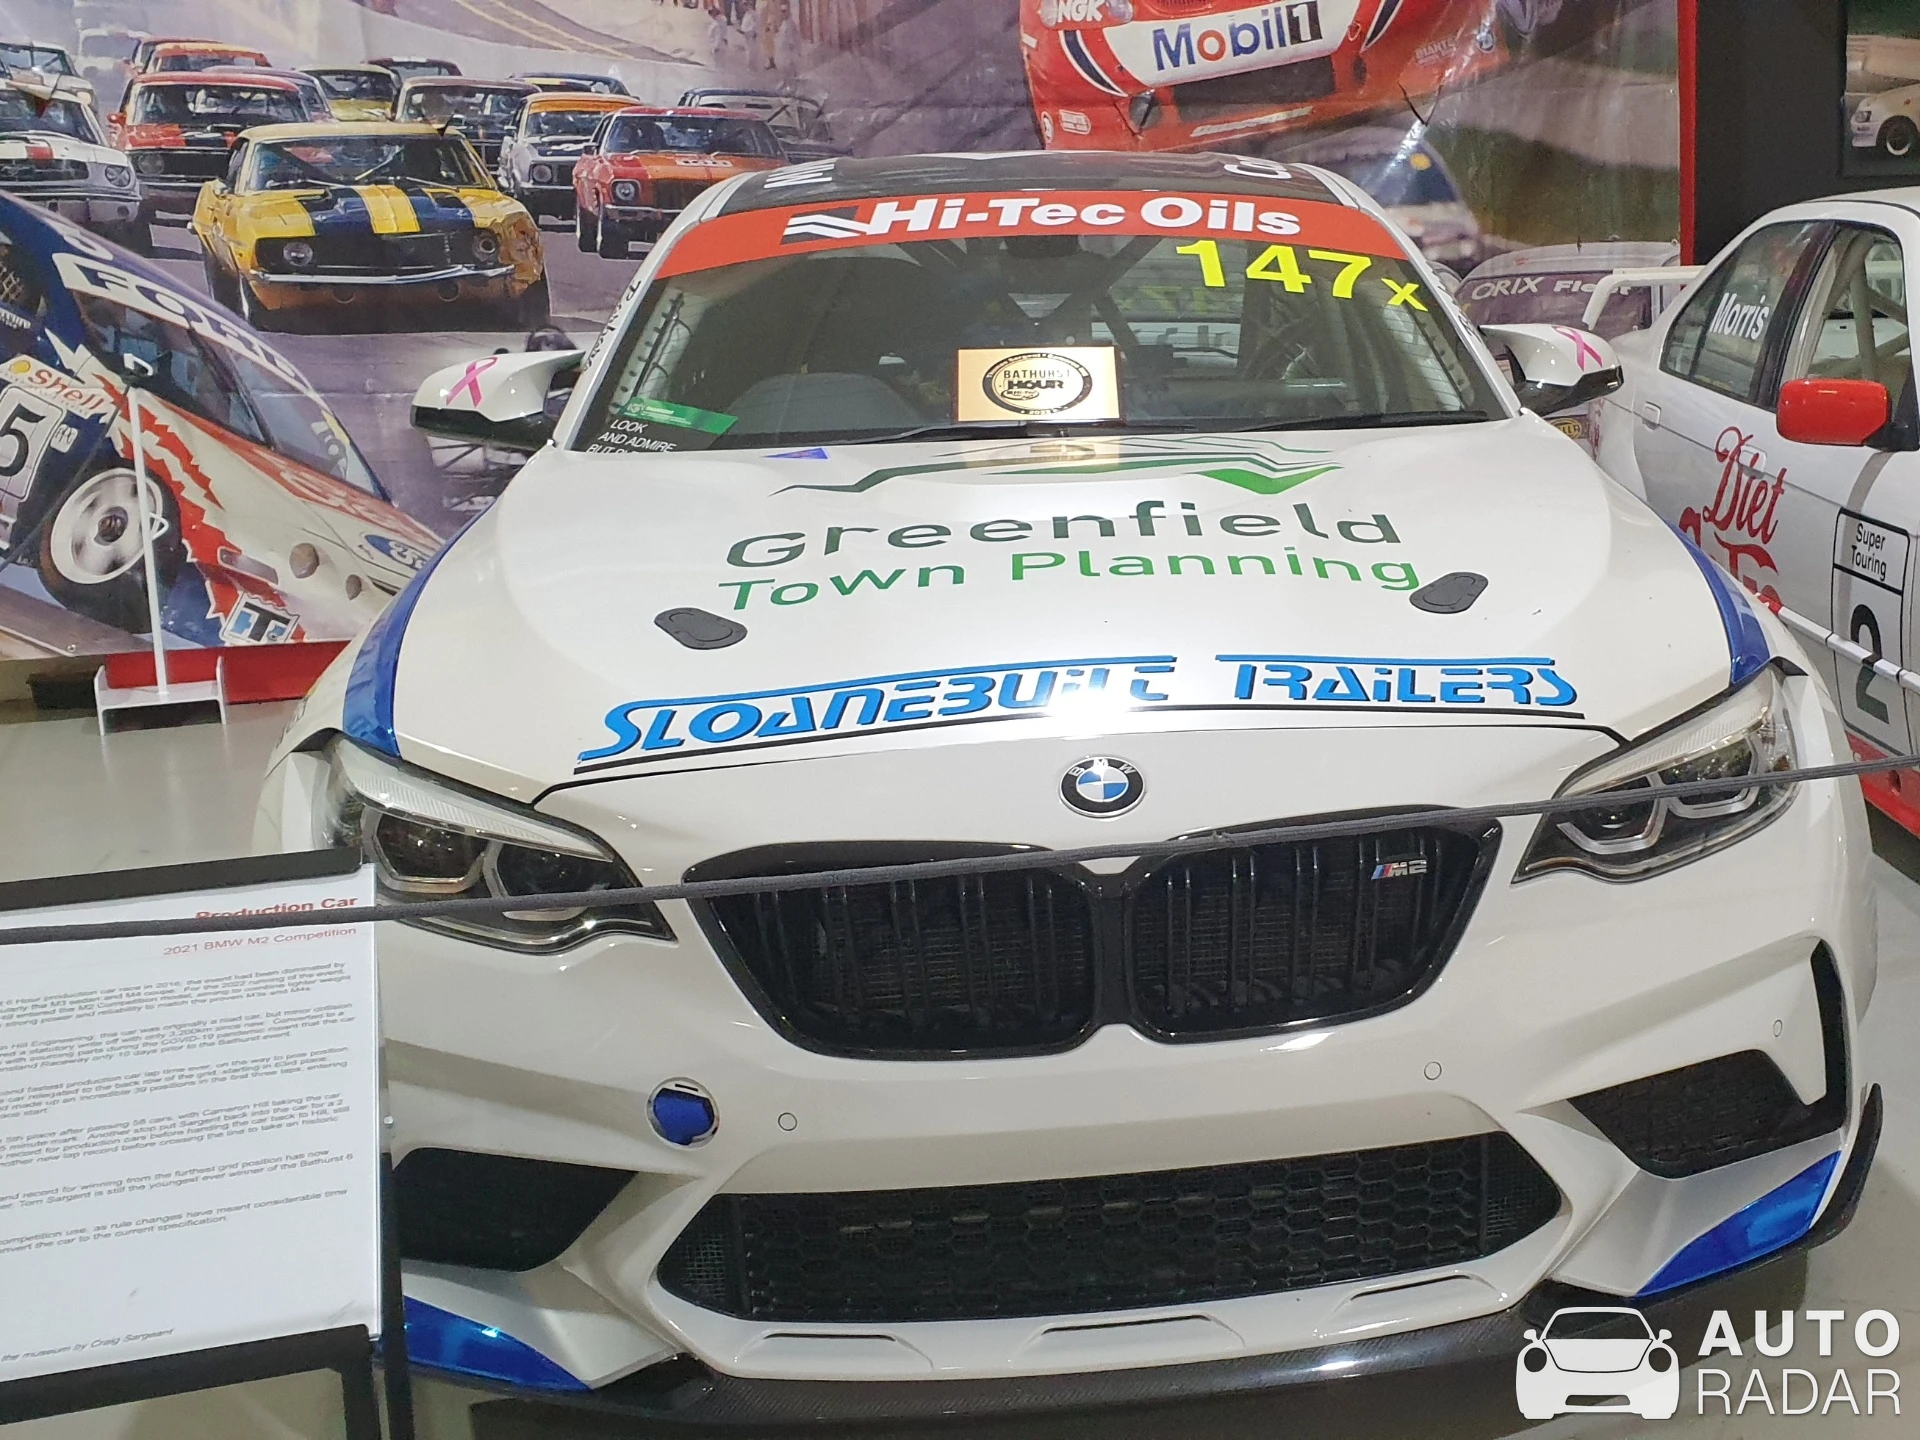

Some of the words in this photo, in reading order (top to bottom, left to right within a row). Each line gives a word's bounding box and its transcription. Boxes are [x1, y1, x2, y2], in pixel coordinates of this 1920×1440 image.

[1153, 8, 1287, 71] Mobil
[867, 197, 1125, 234] Hi-Tec
[1140, 196, 1301, 235] Oils
[1471, 277, 1544, 300] ORIX
[1553, 280, 1632, 296] Flet
[1709, 292, 1770, 340] Morris
[28, 369, 105, 411] Shell
[598, 432, 627, 444] AND
[625, 436, 677, 452] ADMIRE
[610, 419, 648, 434] LOOK
[1702, 426, 1788, 545] Diet
[726, 500, 1401, 568] Greenfield
[1855, 523, 1887, 552] Super
[718, 563, 964, 611] Town
[1011, 546, 1420, 591] Planning
[1850, 545, 1888, 582] Touring
[1215, 654, 1578, 707] TRAILERS
[321, 897, 358, 908] Car
[164, 943, 199, 956] 2021
[204, 938, 244, 950] BMW
[248, 936, 269, 946] M2
[274, 927, 357, 943] Competition
[73, 1343, 88, 1352] by
